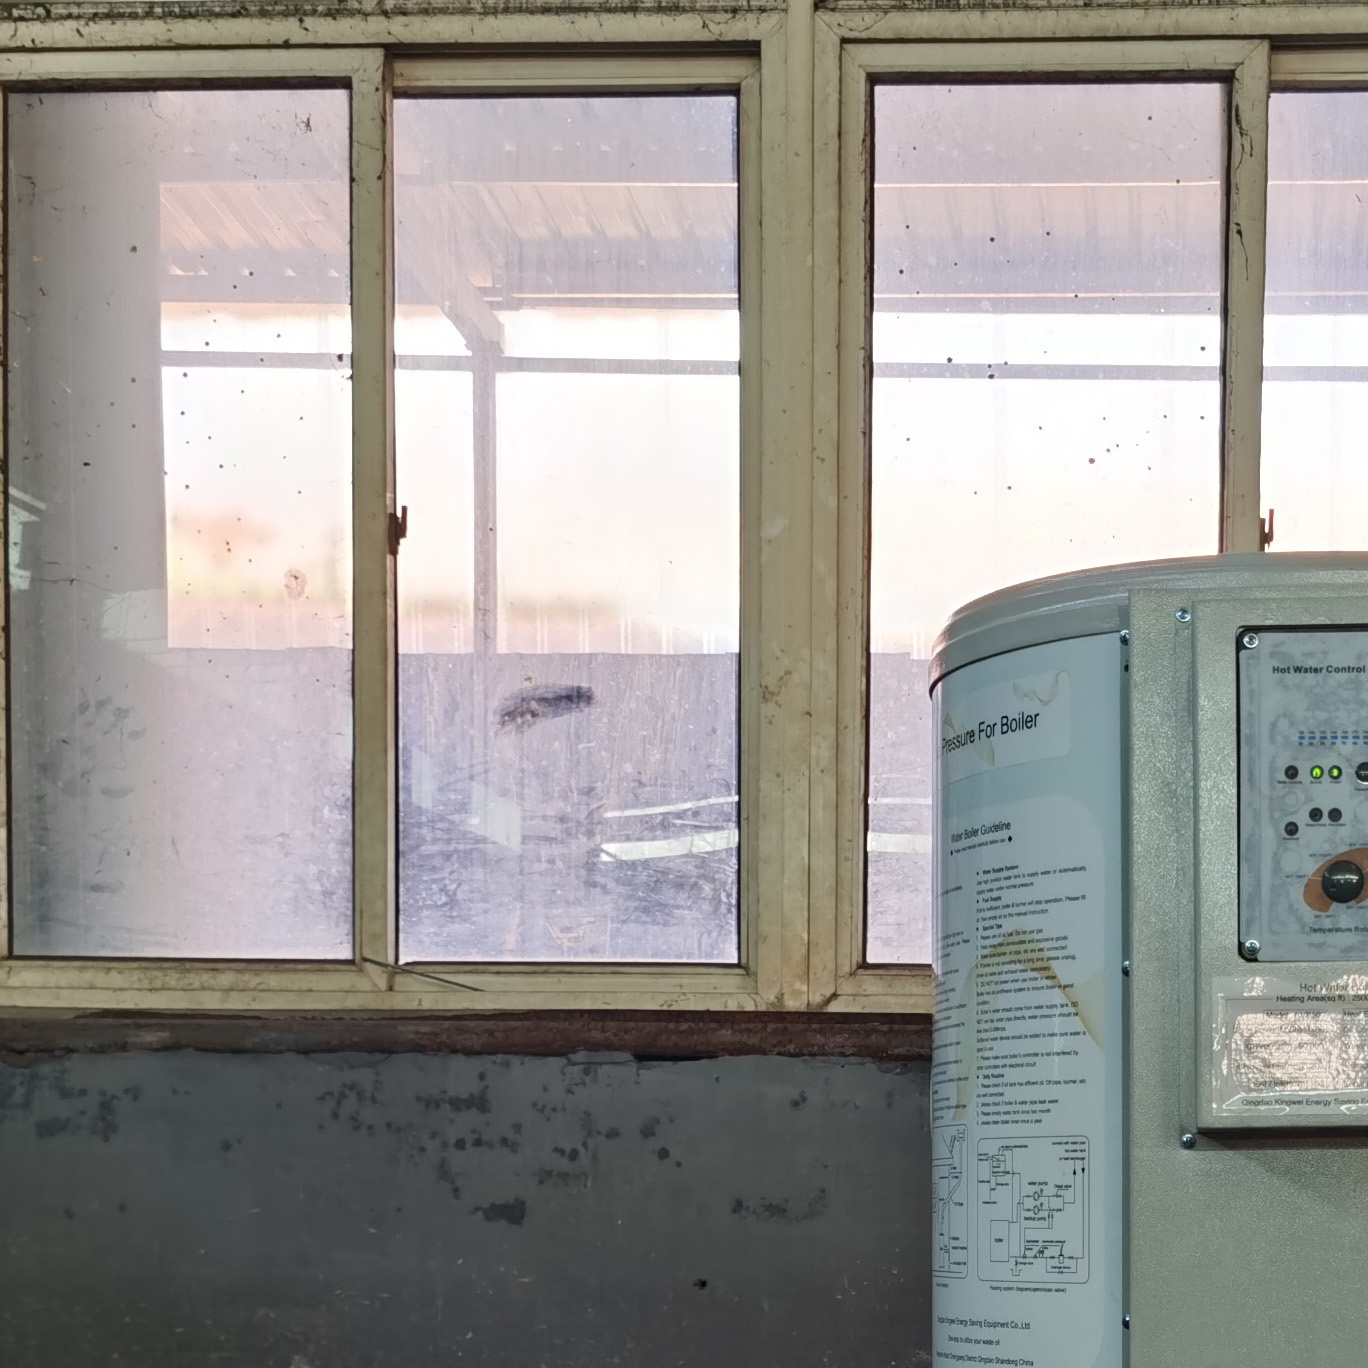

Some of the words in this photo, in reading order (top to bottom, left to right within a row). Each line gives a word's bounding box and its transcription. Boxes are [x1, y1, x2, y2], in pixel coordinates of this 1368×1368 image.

[1272, 666, 1290, 674] Hot
[1292, 665, 1324, 674] Water
[1326, 665, 1365, 674] Control
[978, 720, 998, 741] For
[1000, 711, 1040, 735] Boiler
[964, 828, 980, 840] Boiler
[981, 820, 1011, 835] Guideline
[1300, 982, 1316, 993] Hot
[1276, 995, 1304, 1003] Heating
[1241, 1098, 1272, 1106] Qingdao
[1306, 1098, 1332, 1107] Energy
[984, 1319, 1009, 1329] Equipment
[995, 1356, 1018, 1367] Shandong
[1019, 1359, 1034, 1367] China
